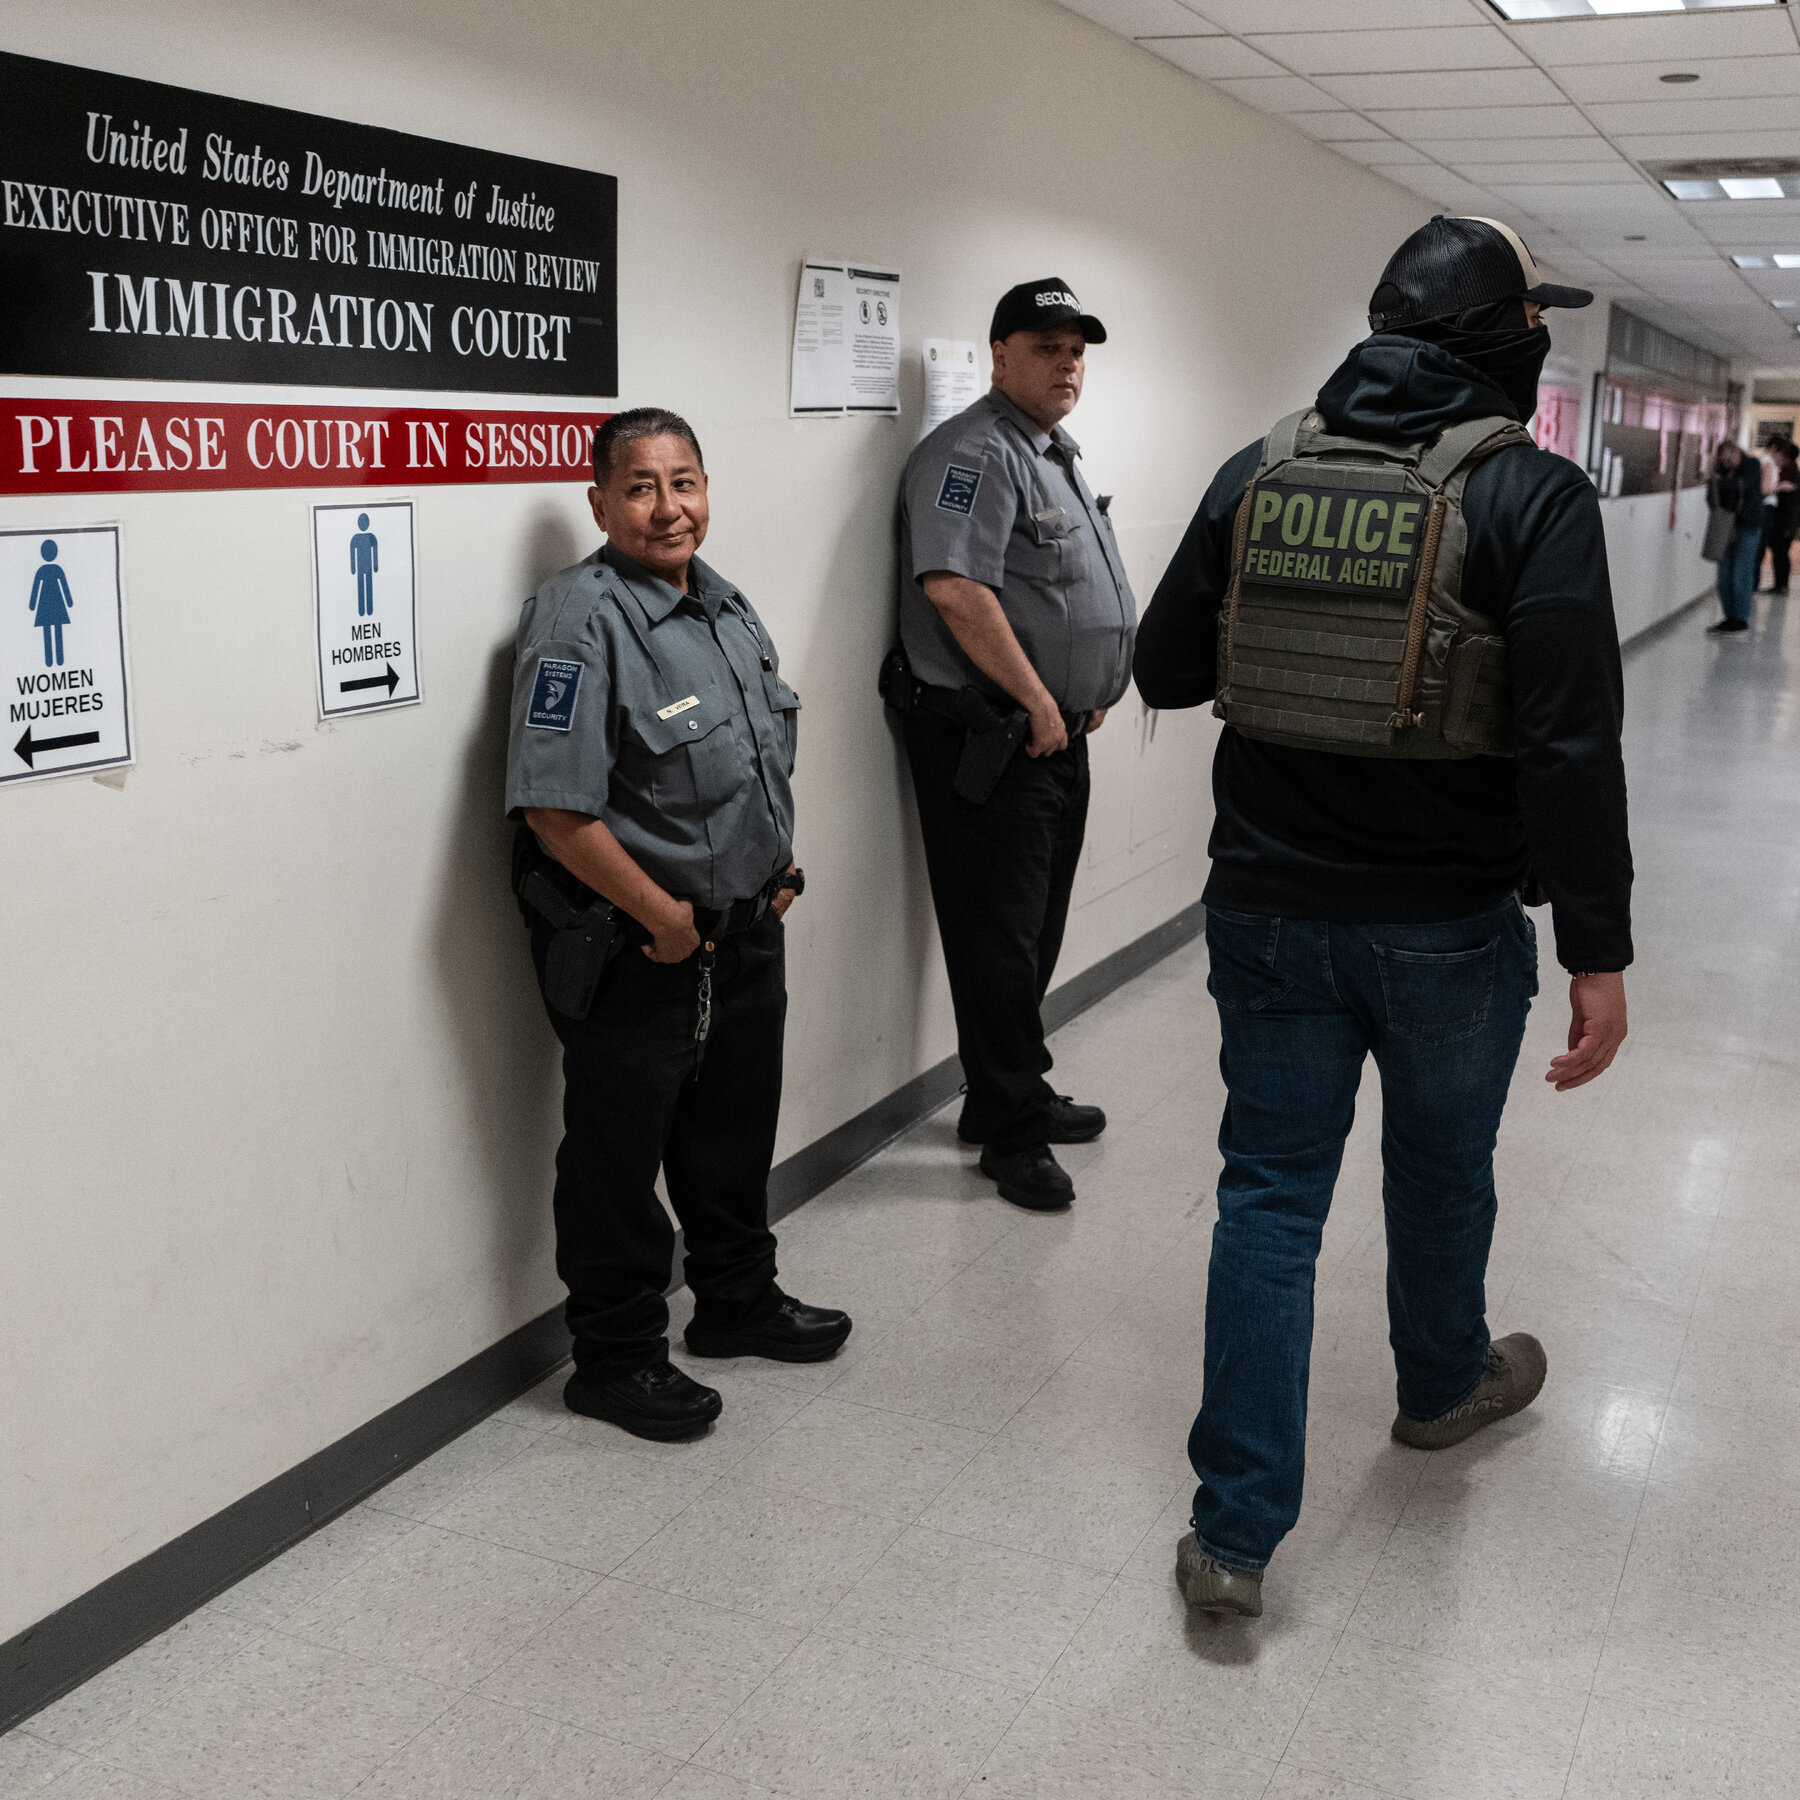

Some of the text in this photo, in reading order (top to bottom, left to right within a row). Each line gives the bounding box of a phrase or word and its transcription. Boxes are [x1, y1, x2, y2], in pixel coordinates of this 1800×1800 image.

[87, 111, 556, 233] United States Department of Justice
[2, 180, 601, 294] EXECUTIVE OFFICE FOR IMMIGRATION REVIEW
[86, 271, 571, 362] IMMIGRATION COURT
[15, 415, 227, 473] PLEASE
[247, 418, 390, 470] COURT
[405, 422, 450, 468] IN
[1250, 490, 1421, 556] POLICE
[1245, 548, 1409, 590] FEDERAL AGENT
[351, 622, 382, 641] MEN
[331, 641, 402, 666] HOMBRES
[543, 663, 578, 673] PARAGON
[16, 668, 94, 696] WOMEN
[544, 671, 573, 680] SYSTEMS
[10, 692, 104, 723] MUJERES
[532, 711, 568, 722] SECURITY
